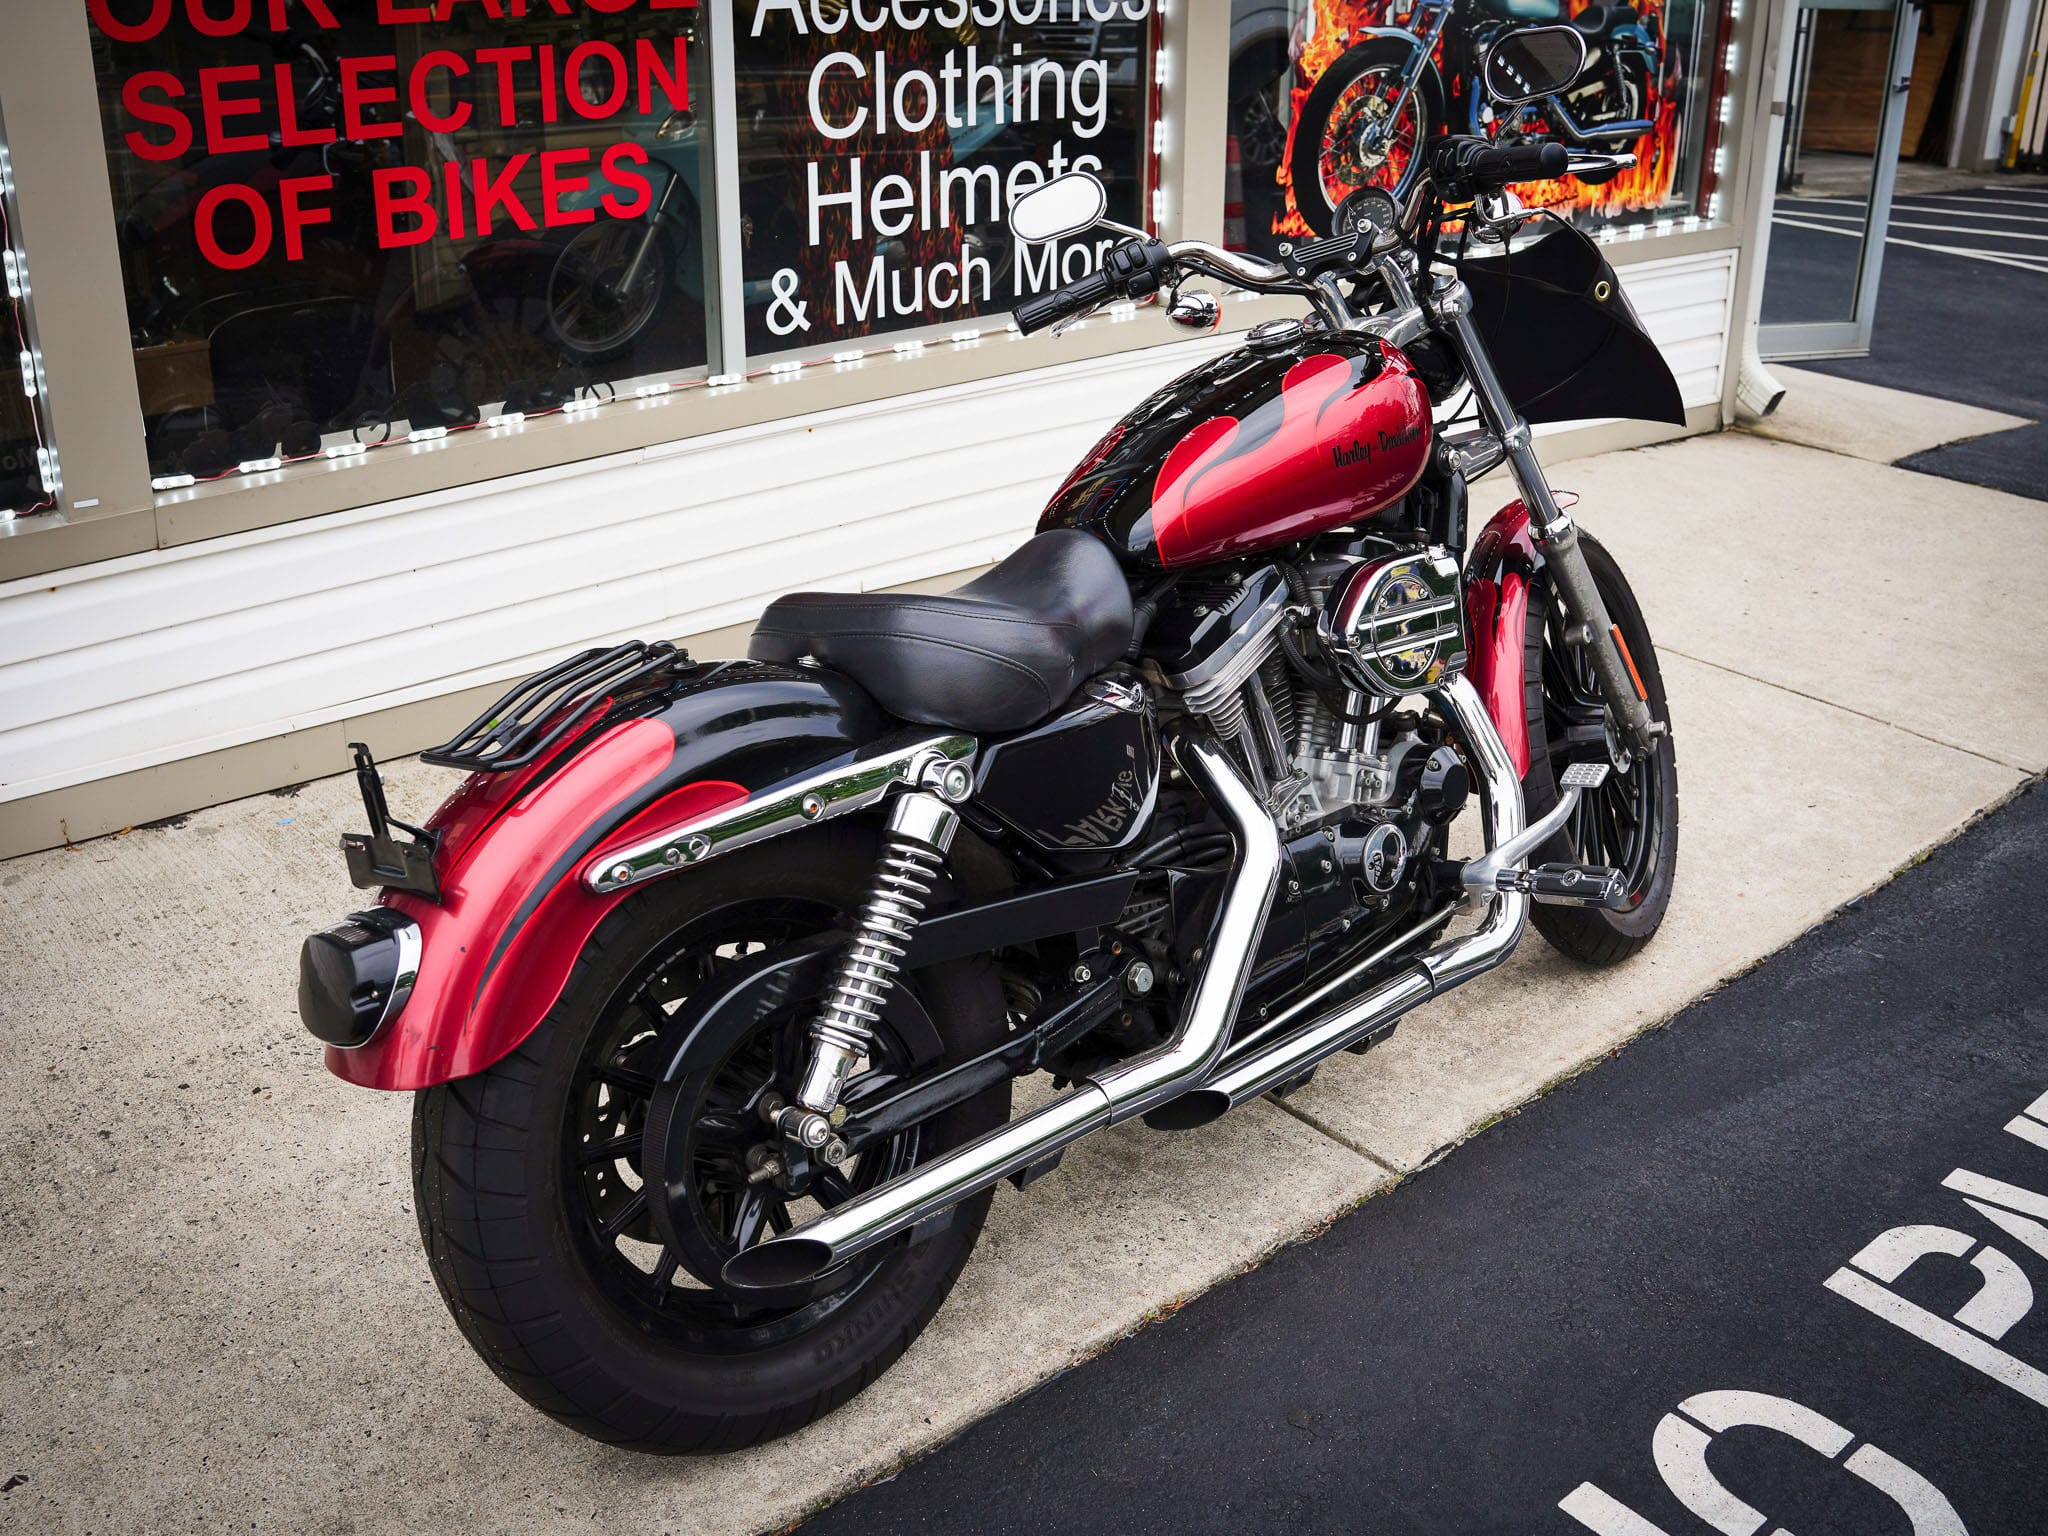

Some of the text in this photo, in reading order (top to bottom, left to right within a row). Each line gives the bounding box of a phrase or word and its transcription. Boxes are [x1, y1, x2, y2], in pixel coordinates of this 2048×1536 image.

[121, 37, 690, 161] SELECTION
[808, 43, 1107, 139] Clothing
[194, 141, 653, 270] OF BIKES
[807, 140, 1103, 246] Helmet
[765, 236, 1135, 336] & Much Mor
